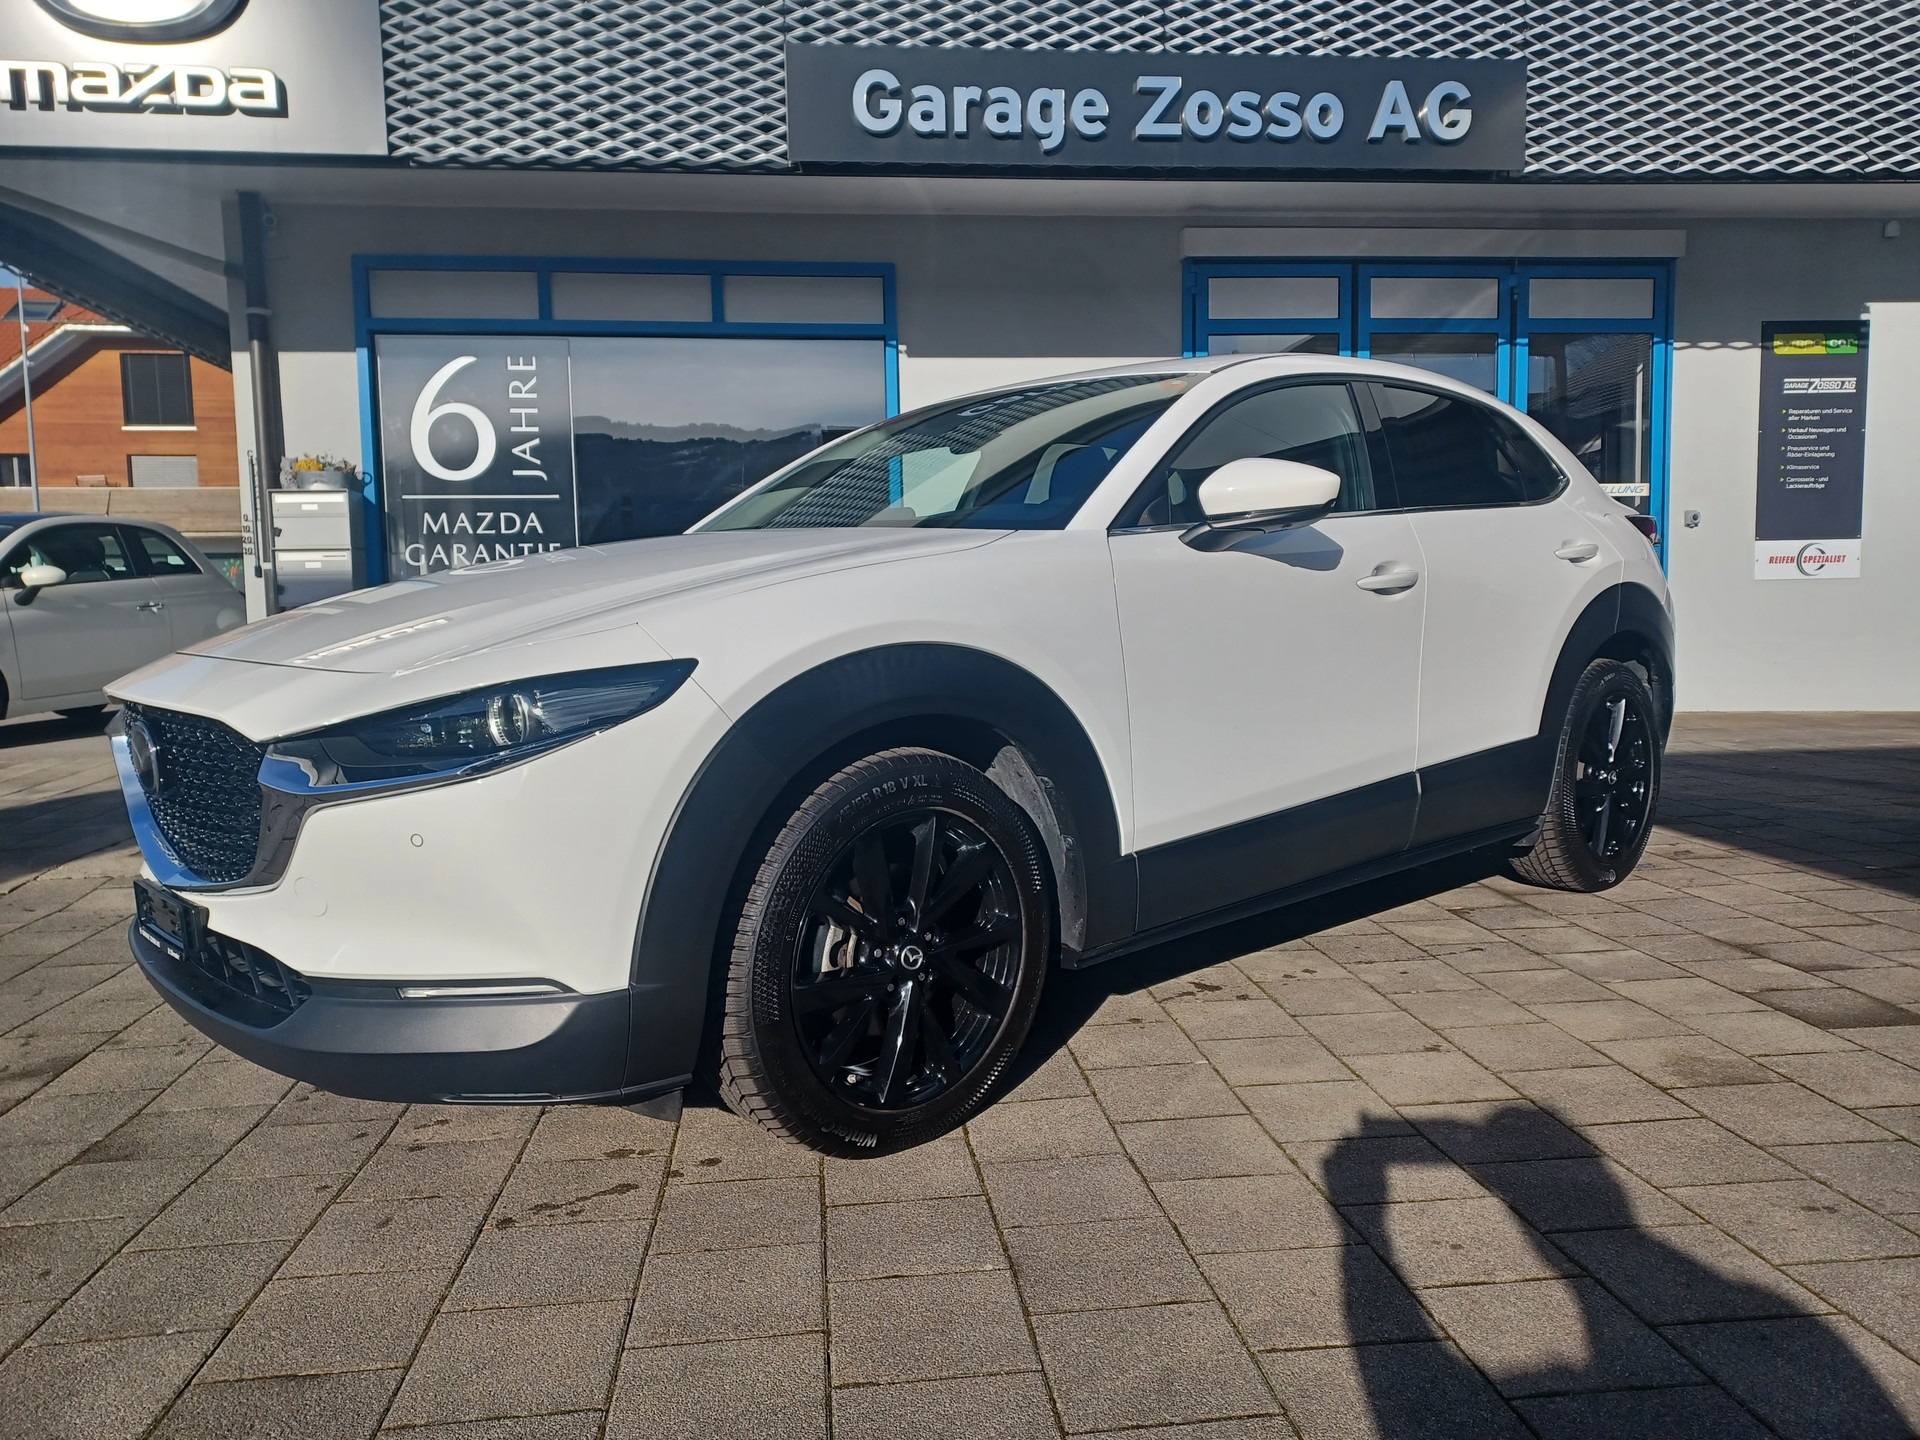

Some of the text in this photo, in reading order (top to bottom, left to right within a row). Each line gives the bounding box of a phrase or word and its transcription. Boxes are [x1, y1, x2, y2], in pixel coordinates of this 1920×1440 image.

[851, 68, 1473, 153] Garage Zosso AG
[1807, 377, 1842, 394] ZOSSO
[1842, 381, 1856, 389] AG
[410, 355, 497, 482] 6
[506, 355, 548, 482] JAHRE
[422, 511, 544, 535] MAZDA
[1768, 554, 1847, 564] REIFEN SPEZIALIST
